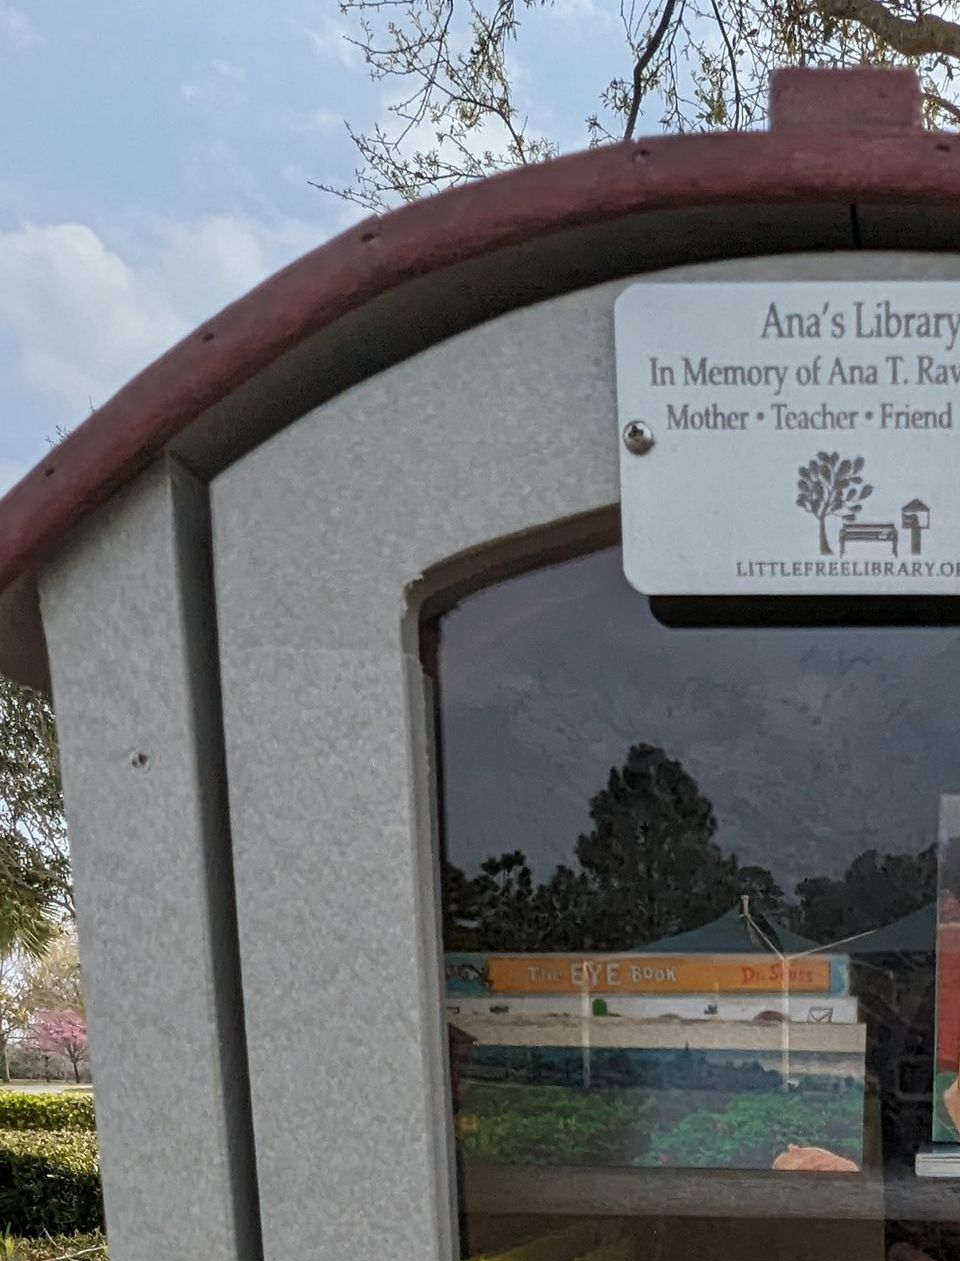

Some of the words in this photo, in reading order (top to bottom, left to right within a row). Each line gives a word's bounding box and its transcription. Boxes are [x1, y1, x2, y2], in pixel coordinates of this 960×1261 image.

[760, 302, 845, 340] Ana's
[650, 357, 674, 386] In
[682, 357, 787, 395] Memory
[796, 355, 821, 386] of
[828, 355, 878, 386] Ana
[885, 355, 908, 385] T.
[667, 404, 749, 431] Mother
[770, 404, 858, 430] Teacher
[880, 404, 952, 430] Friend
[571, 961, 622, 986] EYE
[741, 967, 765, 984] Dr.
[769, 965, 813, 984] Seuss
